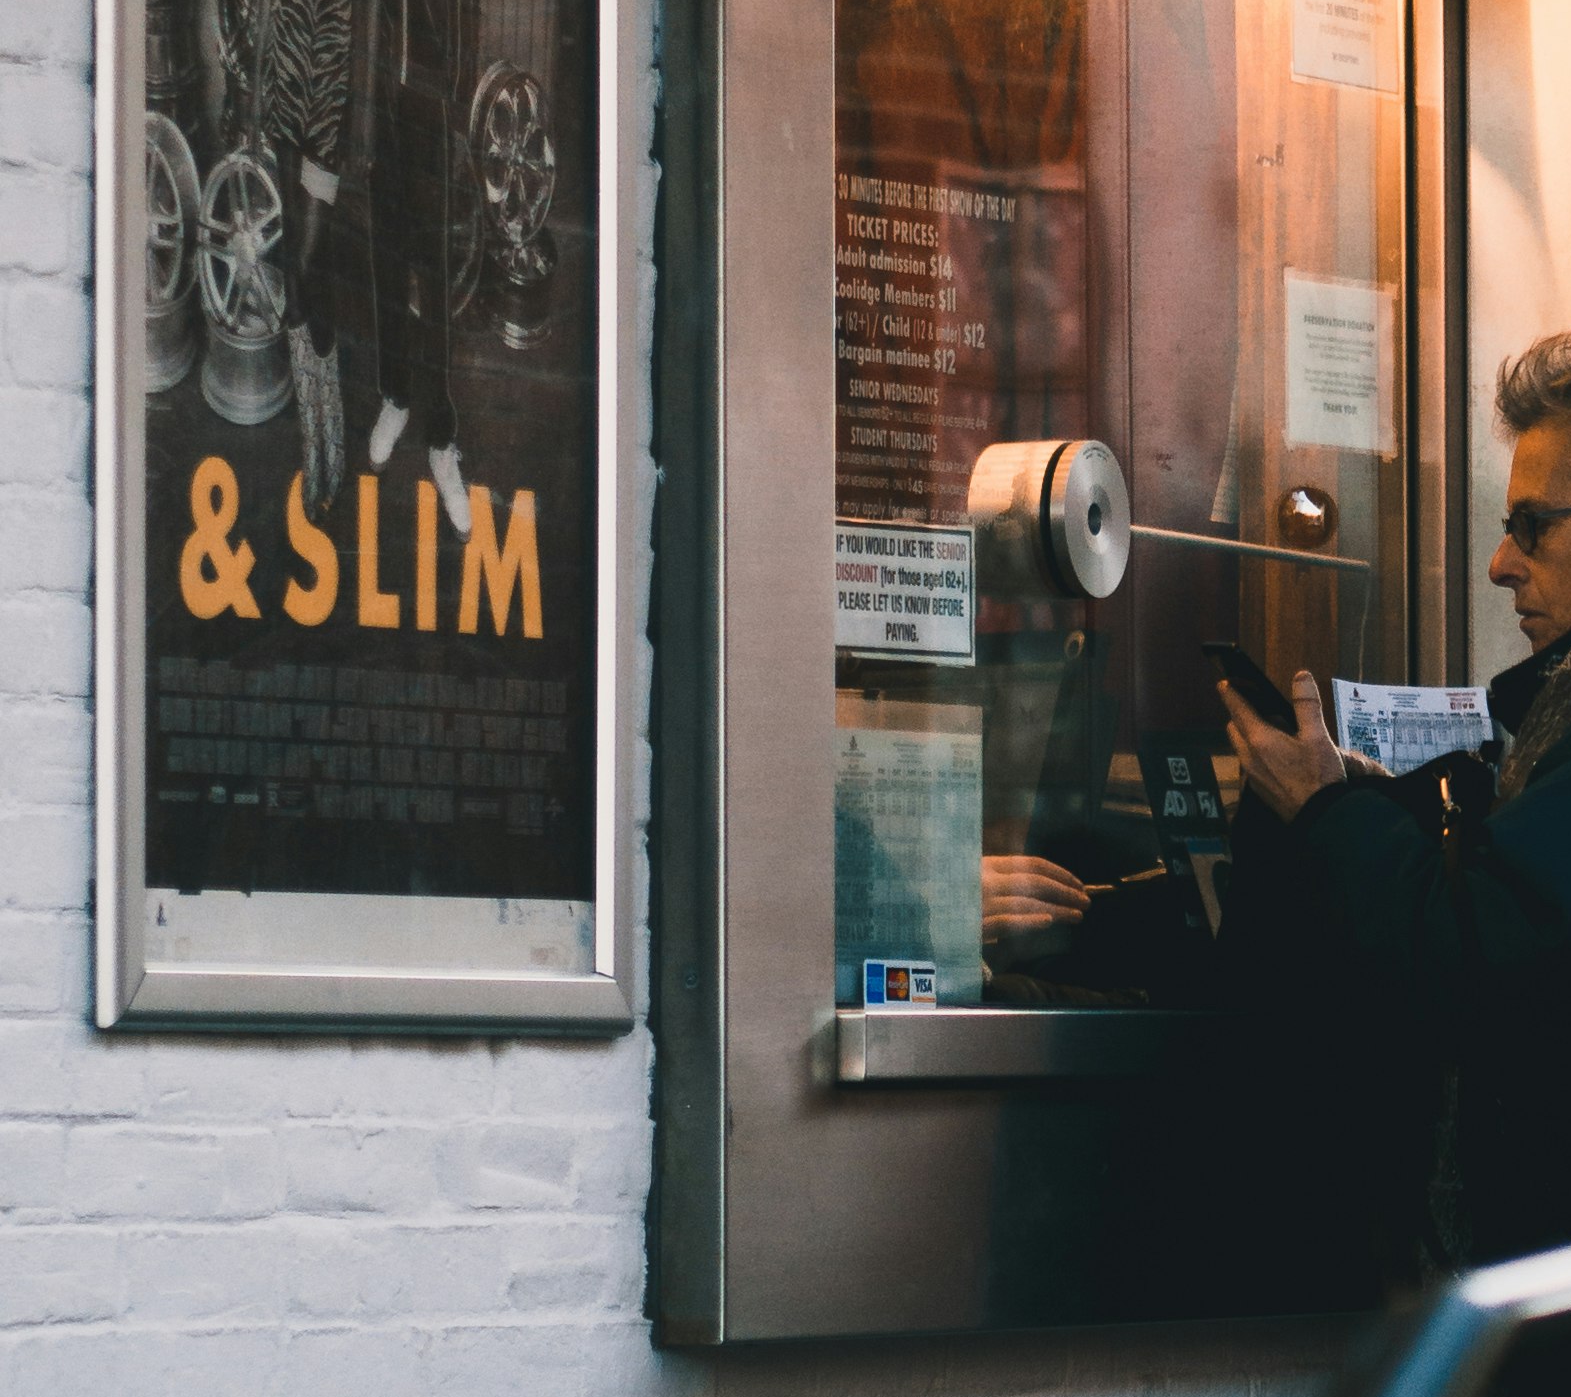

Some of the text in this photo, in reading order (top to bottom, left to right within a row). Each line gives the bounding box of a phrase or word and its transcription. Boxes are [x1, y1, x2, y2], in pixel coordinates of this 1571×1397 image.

[850, 175, 882, 204] MINUTES
[884, 180, 912, 208] BEFORE
[914, 184, 927, 210] THE
[929, 186, 949, 212] FIRST
[950, 189, 973, 216] SHOW
[974, 193, 984, 219] OF
[986, 194, 999, 220] THE
[1001, 197, 1016, 223] DAY
[847, 213, 939, 248] TICKET PRICES:
[837, 244, 953, 281] Adult admission $14
[884, 283, 935, 309] Members
[938, 287, 957, 314] $11
[845, 310, 871, 338] (62+)
[882, 314, 910, 338] Child
[964, 322, 986, 349] $12
[838, 339, 956, 375] Bargain matinee $12
[849, 379, 939, 406] SENIOR WEDNESDAYS
[851, 426, 938, 453] STUDENT THURSDAYS
[179, 456, 545, 639] & SLIM
[836, 534, 967, 561] IF YOU WOULD LIKE THE SENIOR
[836, 563, 878, 583] DISCOUNT
[898, 567, 921, 586] those
[923, 571, 943, 591] aged
[838, 591, 964, 617] PLEASE LET US KNOW BEFORE
[885, 622, 919, 642] PAYING.
[914, 978, 933, 993] VISA
